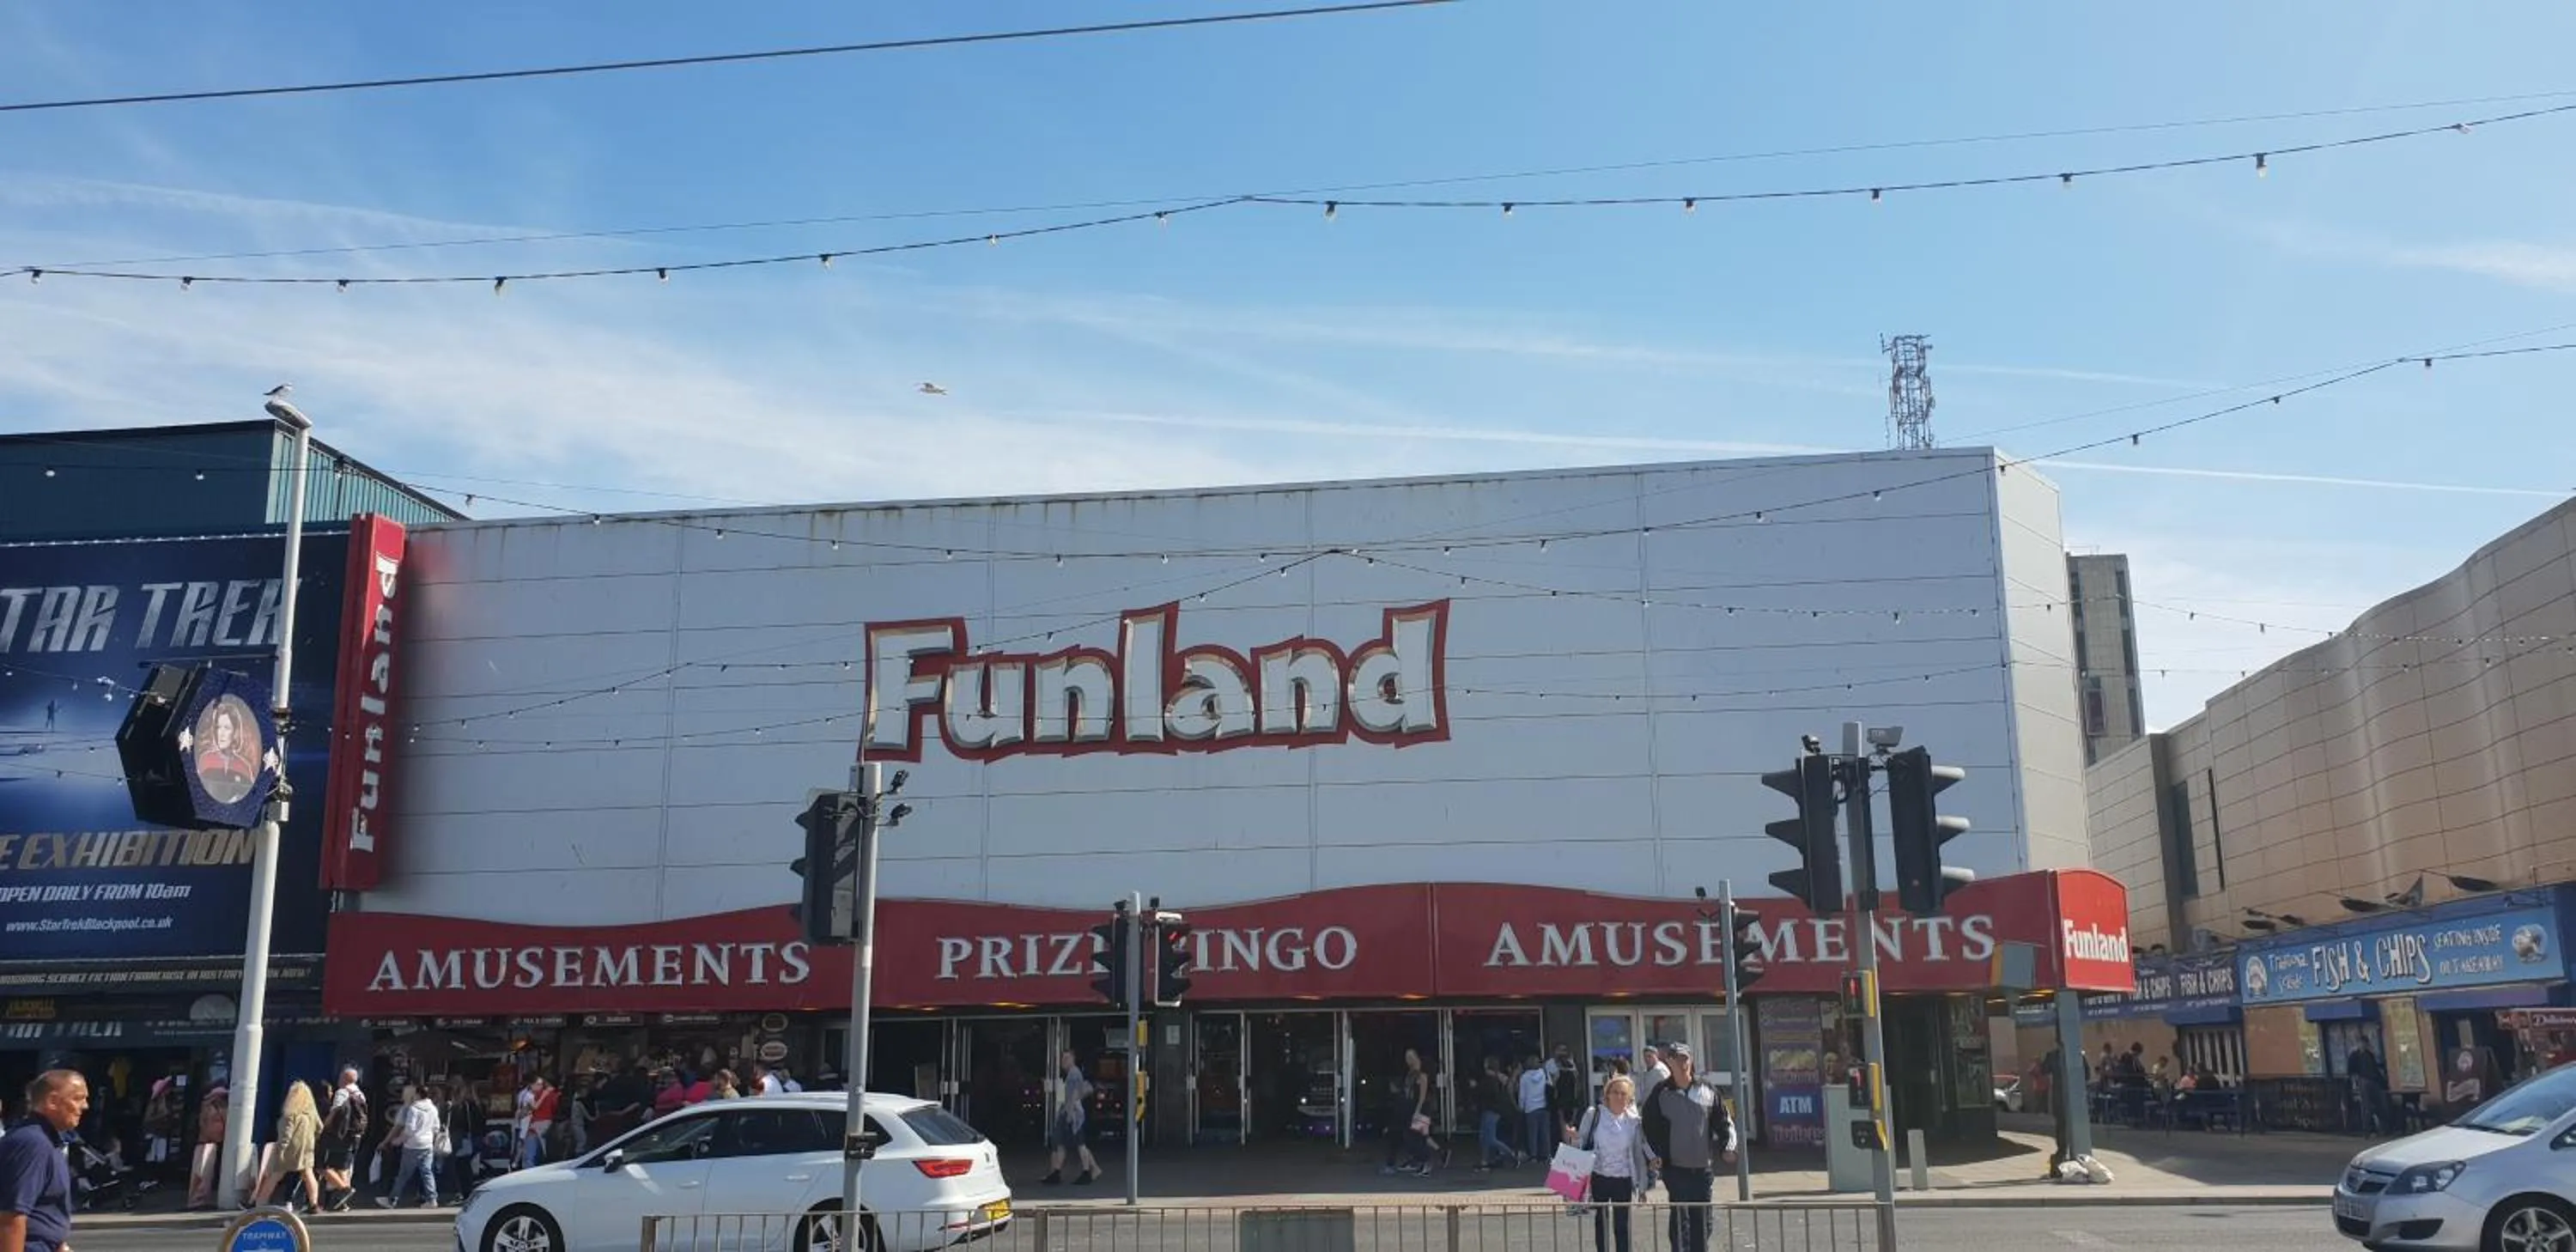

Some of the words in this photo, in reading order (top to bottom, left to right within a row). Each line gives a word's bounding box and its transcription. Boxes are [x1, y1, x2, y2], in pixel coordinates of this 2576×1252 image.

[135, 578, 302, 648] TREK
[349, 553, 398, 853] Funland
[863, 603, 1442, 754] Funland
[17, 829, 258, 870] EXHIBITION
[0, 886, 42, 903] OPEN
[43, 884, 94, 902] DAILY
[94, 883, 143, 901] FROM
[144, 883, 191, 899] 10am
[367, 941, 810, 991] AMUSEMENTS
[1149, 925, 1358, 977] INGO
[1483, 915, 1996, 967] AMUSEMENTS
[2063, 919, 2129, 963] Funland
[2311, 942, 2350, 992] FISH
[2354, 940, 2371, 984] &
[2376, 933, 2431, 983] CHIPS
[1779, 1096, 1814, 1115] ATM
[242, 1231, 288, 1241] TRAMWAY
